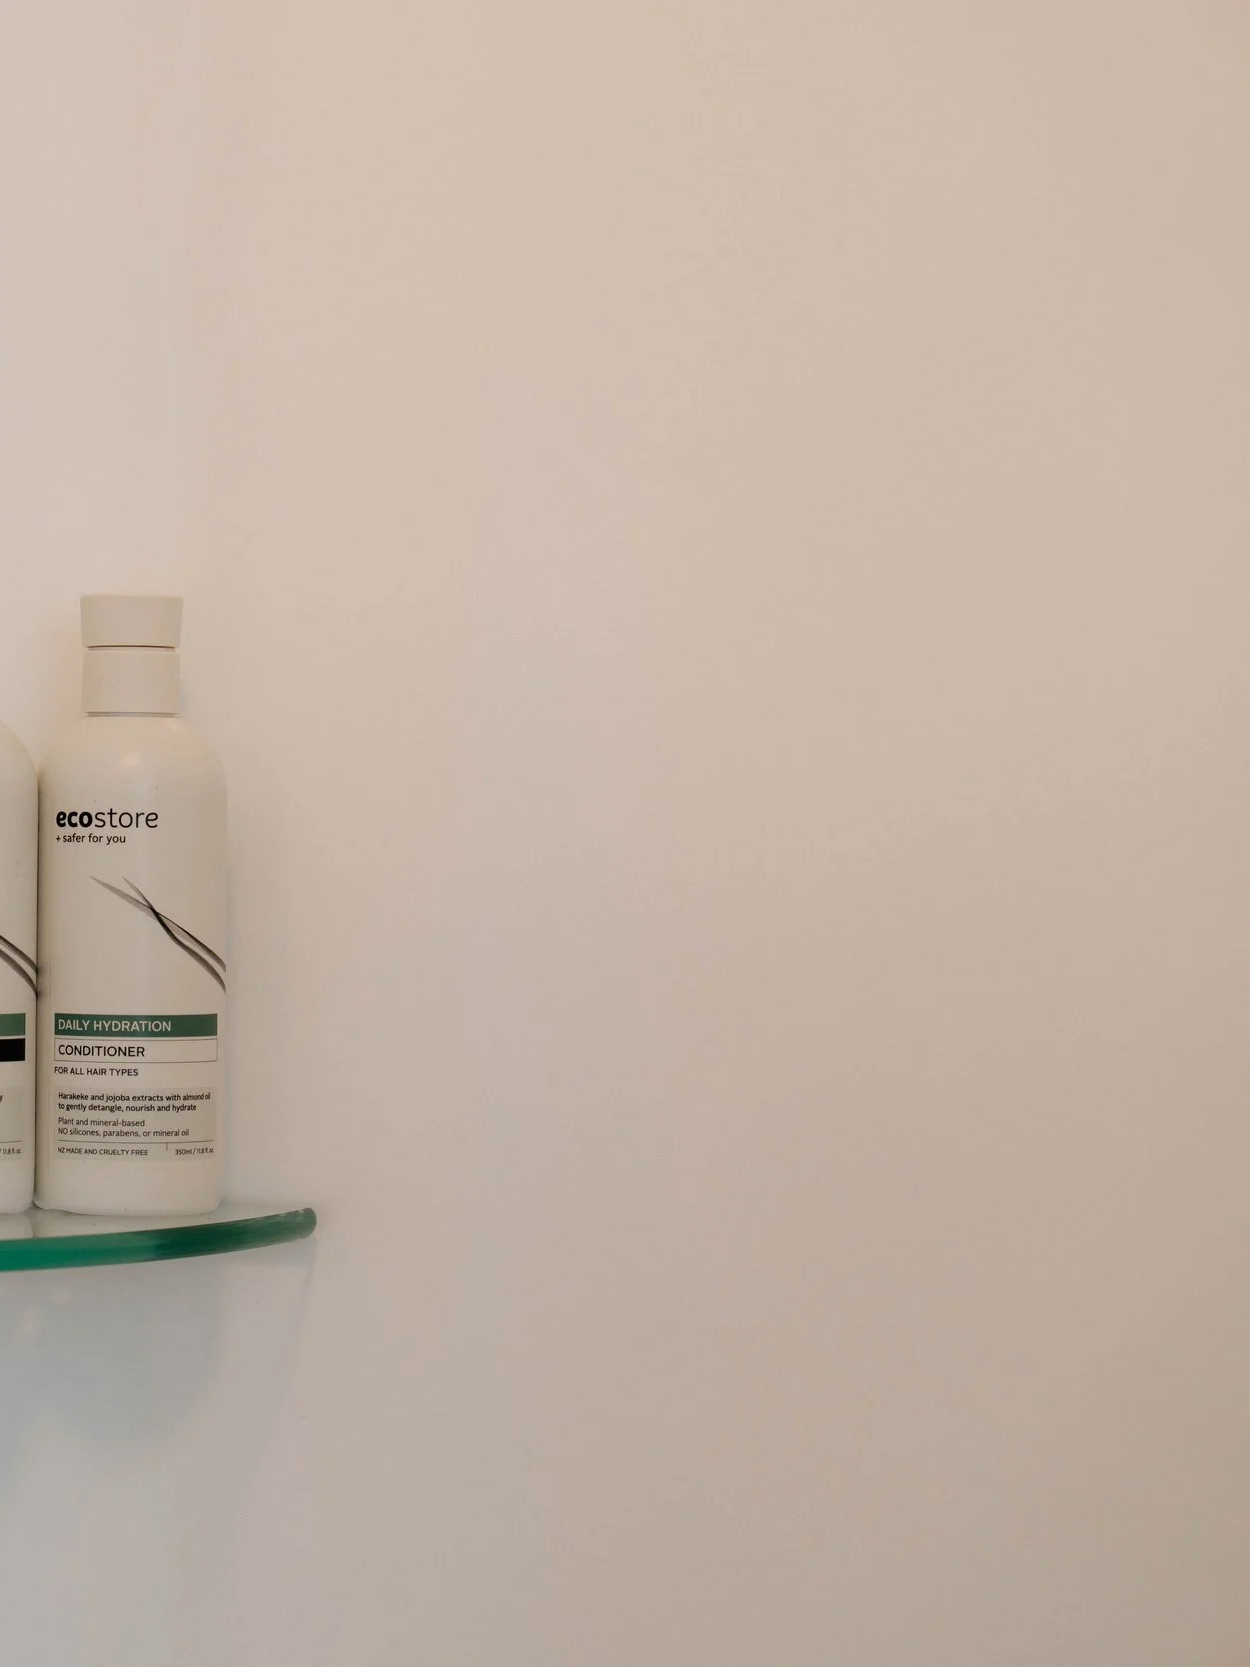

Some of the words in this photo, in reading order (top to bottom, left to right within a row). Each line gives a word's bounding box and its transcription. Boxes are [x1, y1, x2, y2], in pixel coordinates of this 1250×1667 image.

[56, 808, 158, 828] ecostore
[63, 833, 85, 843] safer
[88, 833, 103, 843] for
[106, 835, 126, 845] you
[58, 1019, 90, 1030] DAILY
[94, 1021, 171, 1032] HYDRATION
[58, 1045, 145, 1057] CONDITIONER
[87, 1068, 106, 1076] HAIR
[58, 1092, 88, 1101] Harakeke
[90, 1093, 104, 1101] and
[106, 1093, 130, 1102] jojoba
[165, 1093, 181, 1101] with
[183, 1093, 204, 1101] almond
[66, 1103, 87, 1112] gently
[88, 1104, 124, 1113] detangle,
[126, 1104, 155, 1112] nourish
[157, 1104, 170, 1112] and
[172, 1103, 197, 1112] hydrate
[58, 1117, 74, 1125] Plant
[76, 1118, 88, 1126] and
[90, 1118, 145, 1127] mineral-based
[70, 1128, 101, 1137] silicones,
[103, 1129, 140, 1138] parabens,
[153, 1129, 179, 1137] mineral
